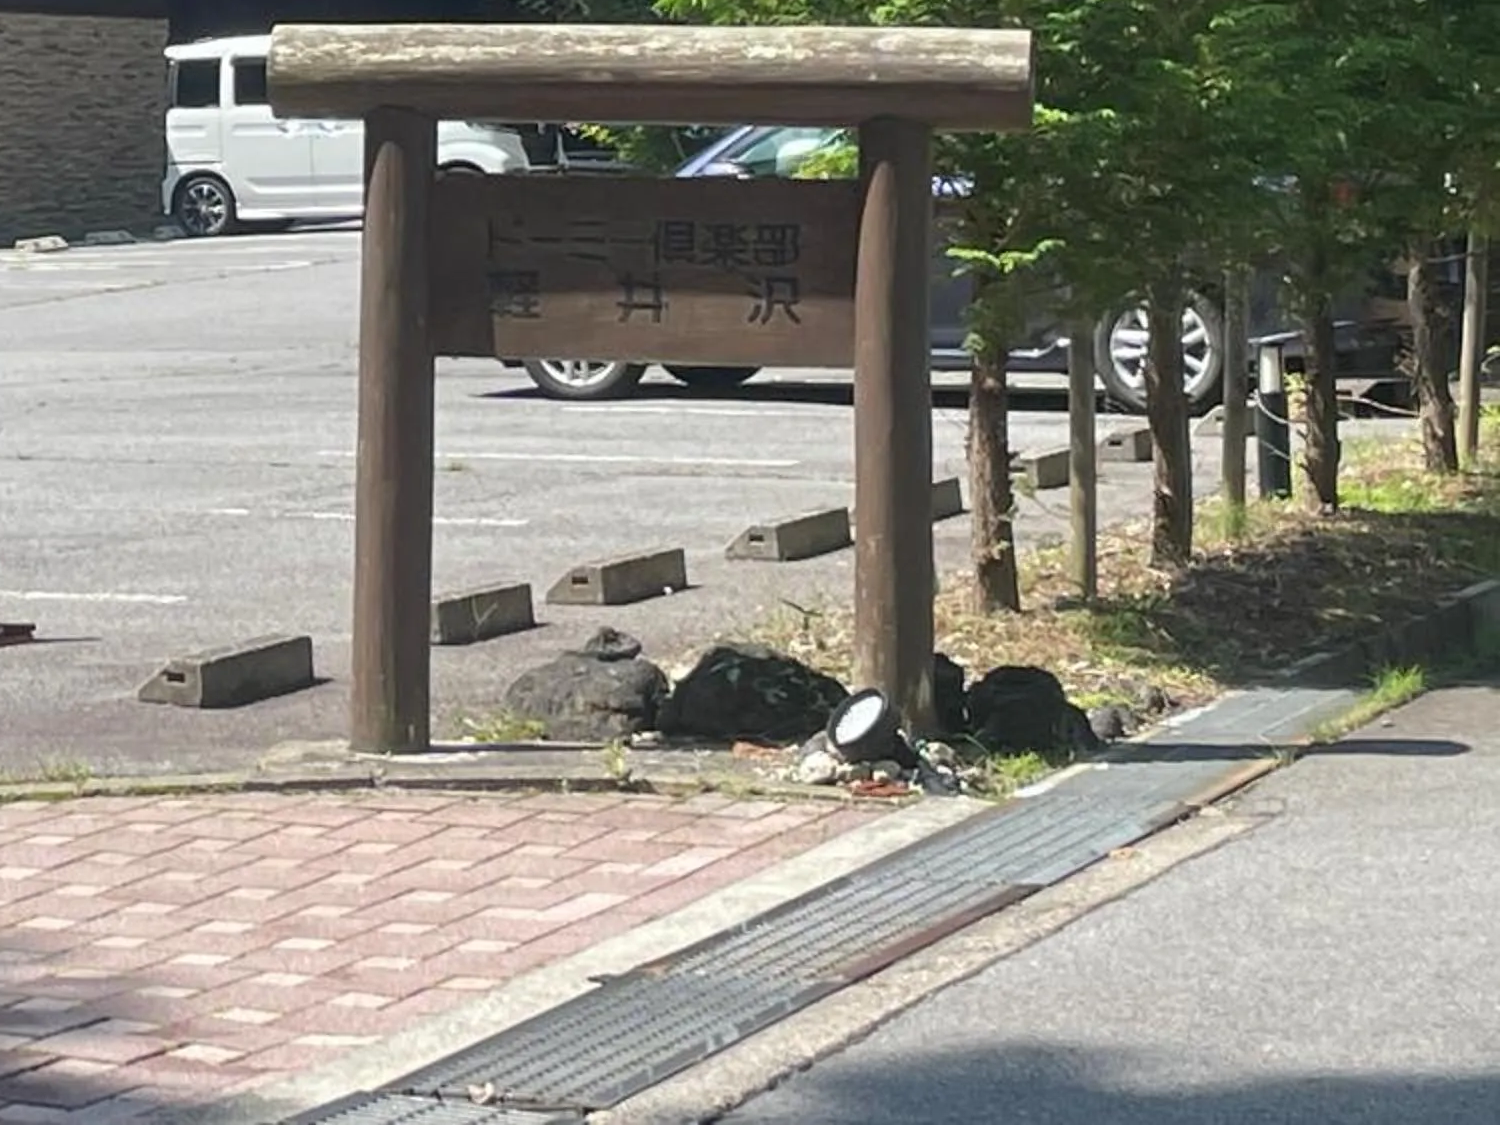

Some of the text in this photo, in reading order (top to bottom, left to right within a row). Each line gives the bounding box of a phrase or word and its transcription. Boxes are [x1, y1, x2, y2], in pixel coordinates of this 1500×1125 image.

[487, 215, 801, 269] ドーミー倶楽部
